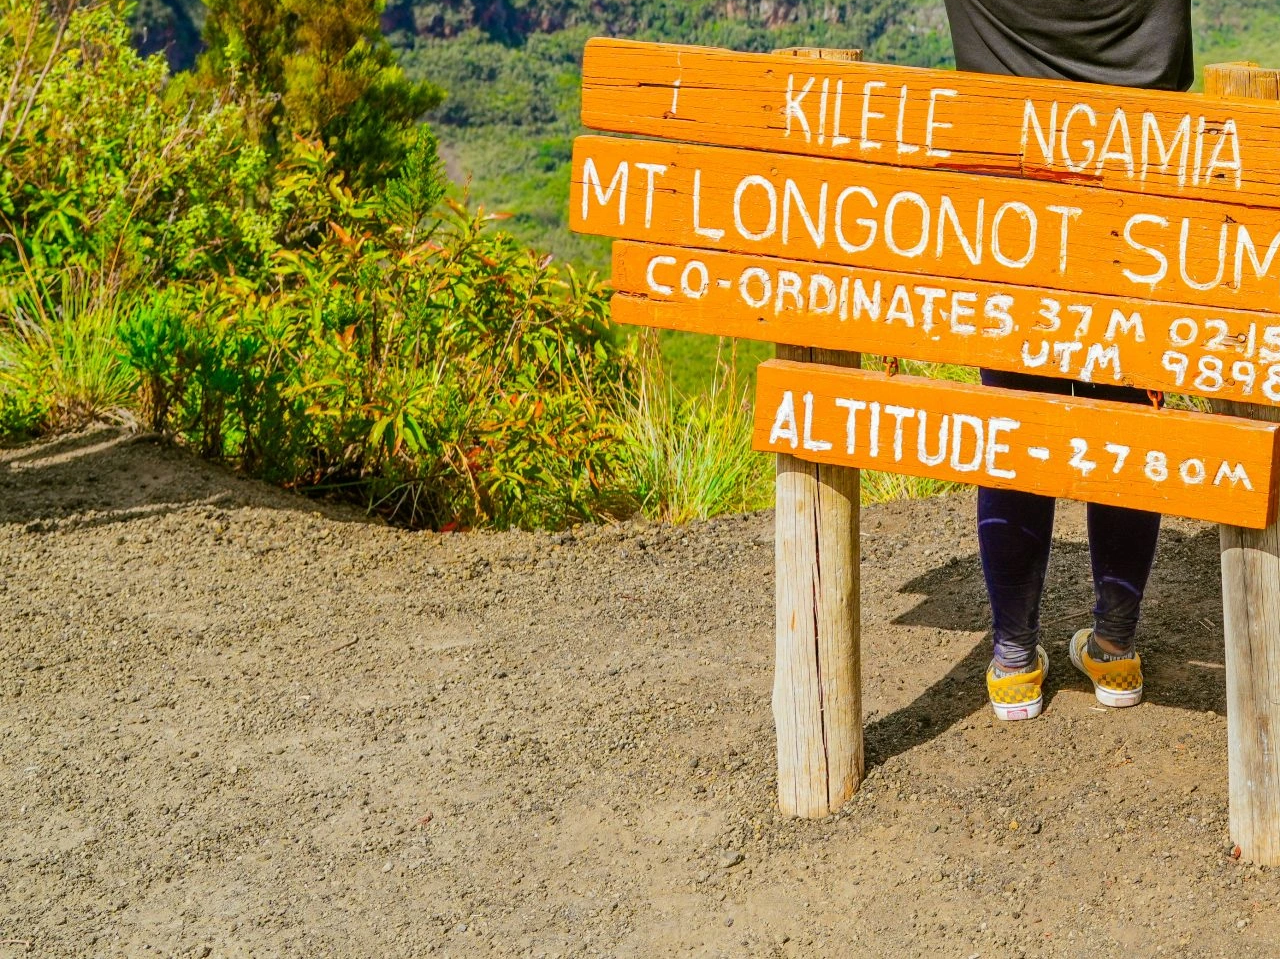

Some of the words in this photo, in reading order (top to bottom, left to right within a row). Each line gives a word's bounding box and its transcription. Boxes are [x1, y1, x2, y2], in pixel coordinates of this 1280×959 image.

[785, 74, 958, 158] KILELE
[1021, 99, 1243, 190] NGAMIA
[582, 157, 667, 229] MT
[693, 169, 1083, 272] LONGONOT
[1021, 340, 1122, 383] UTM
